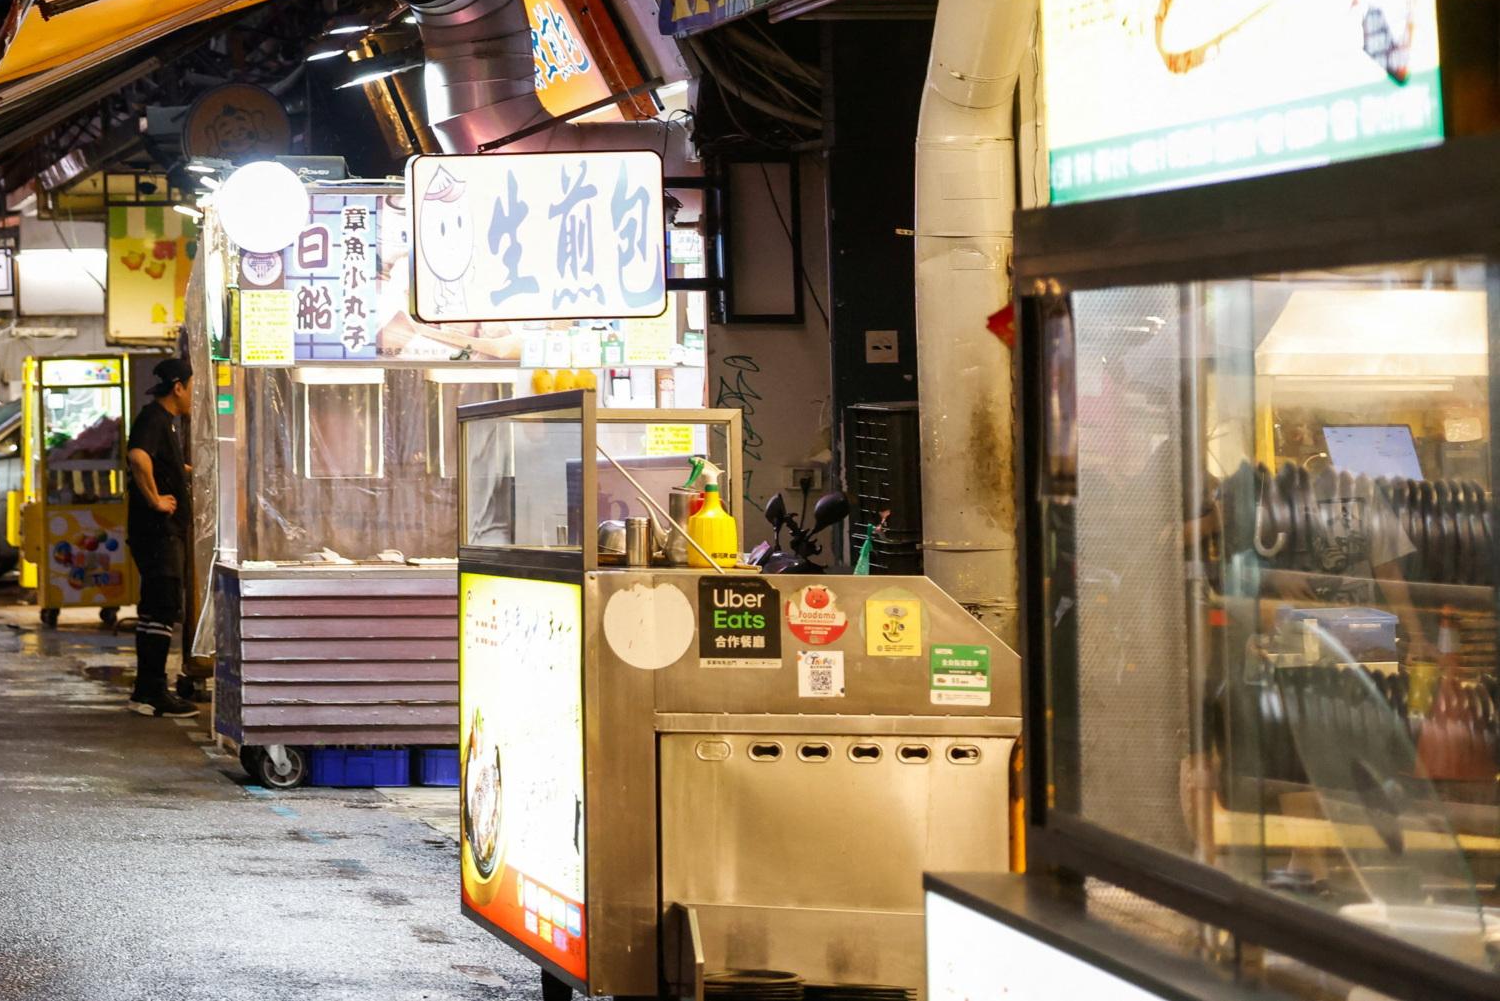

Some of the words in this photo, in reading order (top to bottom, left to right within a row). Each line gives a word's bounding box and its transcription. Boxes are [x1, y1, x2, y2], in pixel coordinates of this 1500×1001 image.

[488, 160, 665, 310] 生煎包
[343, 207, 368, 350] 章魚小丸子
[713, 588, 765, 608] Uber
[714, 610, 765, 629] Eats
[715, 635, 765, 648] 合作餐廳
